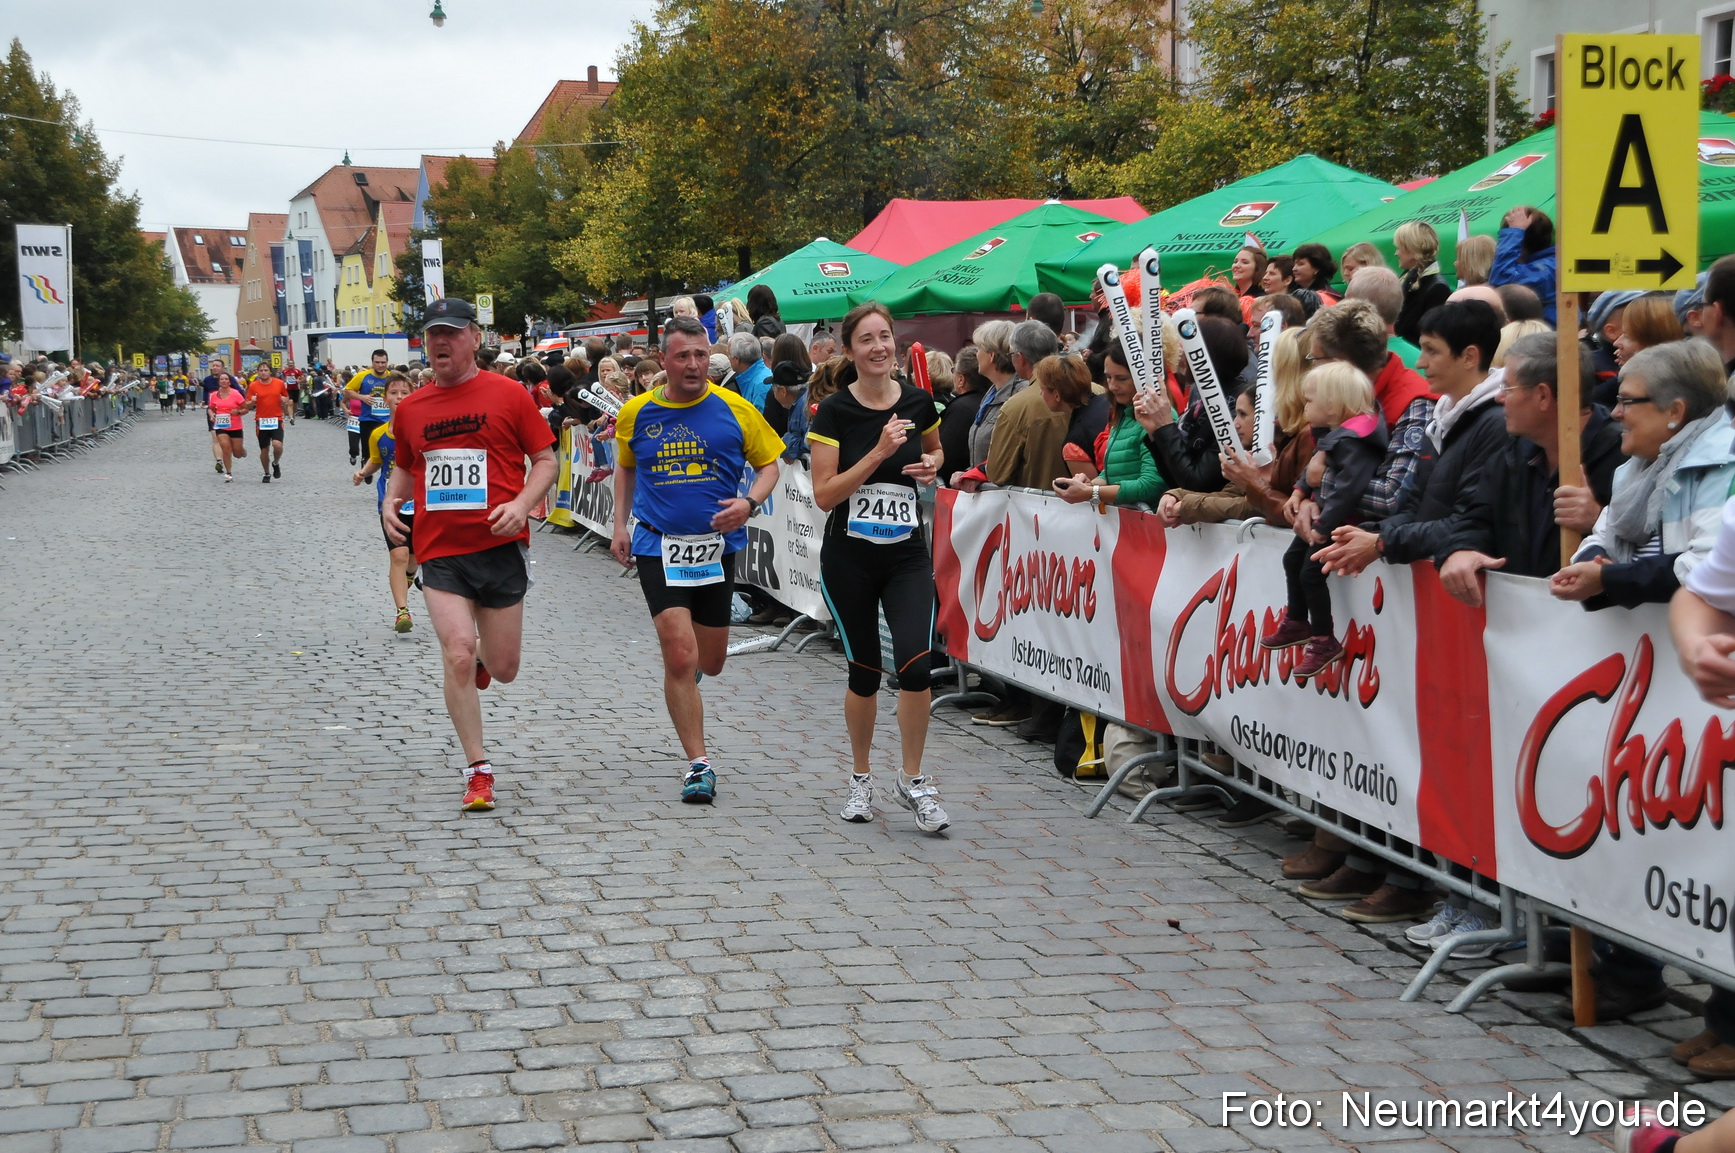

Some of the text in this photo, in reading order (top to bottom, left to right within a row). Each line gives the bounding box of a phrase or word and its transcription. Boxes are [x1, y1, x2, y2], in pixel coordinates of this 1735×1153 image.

[1580, 44, 1686, 91] Block
[1590, 113, 1669, 235] A
[1140, 238, 1287, 253] Lammsbäu
[1188, 348, 1217, 394] BMW
[590, 396, 608, 410] BMW
[430, 464, 480, 486] 2018
[440, 492, 467, 501] Günter
[876, 488, 906, 498] Neumarkt
[856, 497, 912, 523] 2448
[872, 526, 894, 536] Ruth
[668, 543, 720, 564] 2427
[679, 568, 710, 578] Thomas
[974, 511, 1100, 642] Charivari
[1012, 636, 1111, 694] Ostbayerns Radio
[1230, 714, 1398, 806] Ostbayerns Radio
